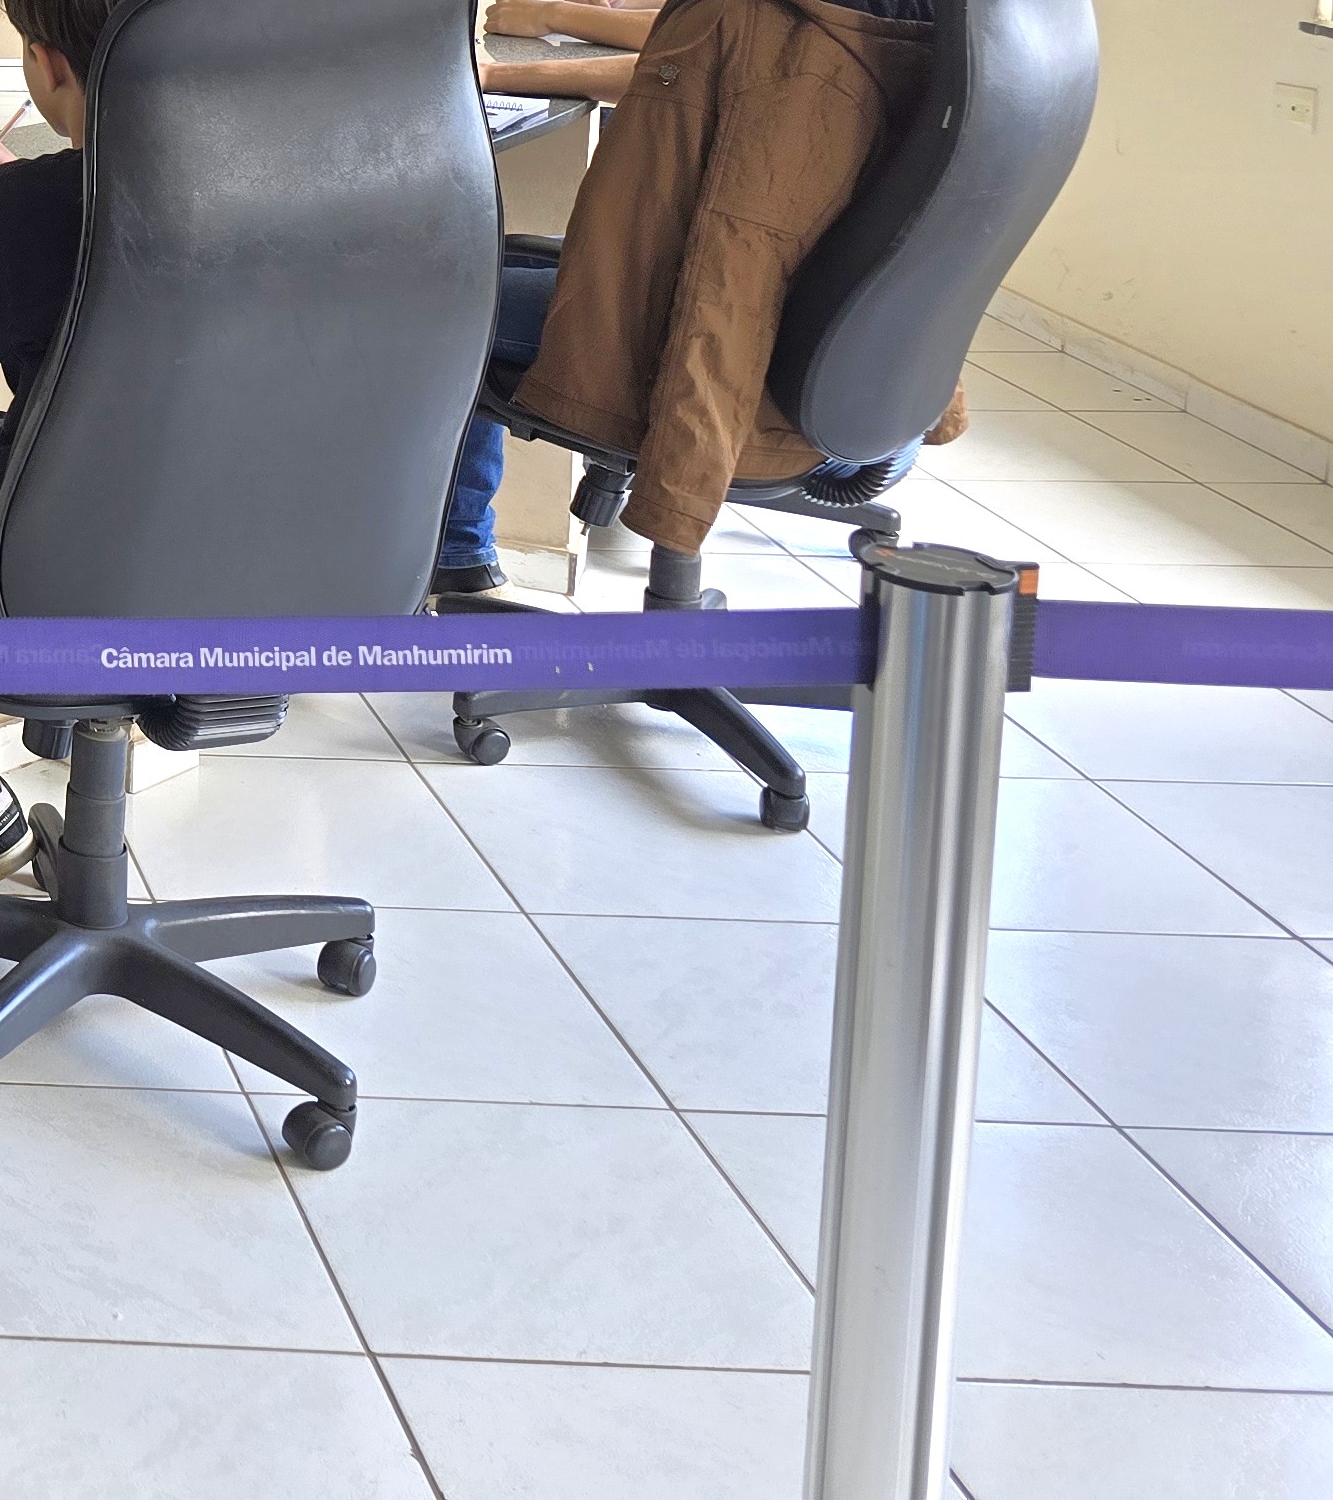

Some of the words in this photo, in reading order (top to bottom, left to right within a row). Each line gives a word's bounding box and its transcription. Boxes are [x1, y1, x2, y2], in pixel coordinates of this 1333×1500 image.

[100, 647, 194, 668] Câmara
[199, 646, 317, 671] Municipal
[322, 645, 353, 667] de
[358, 644, 513, 666] Manhumirim
